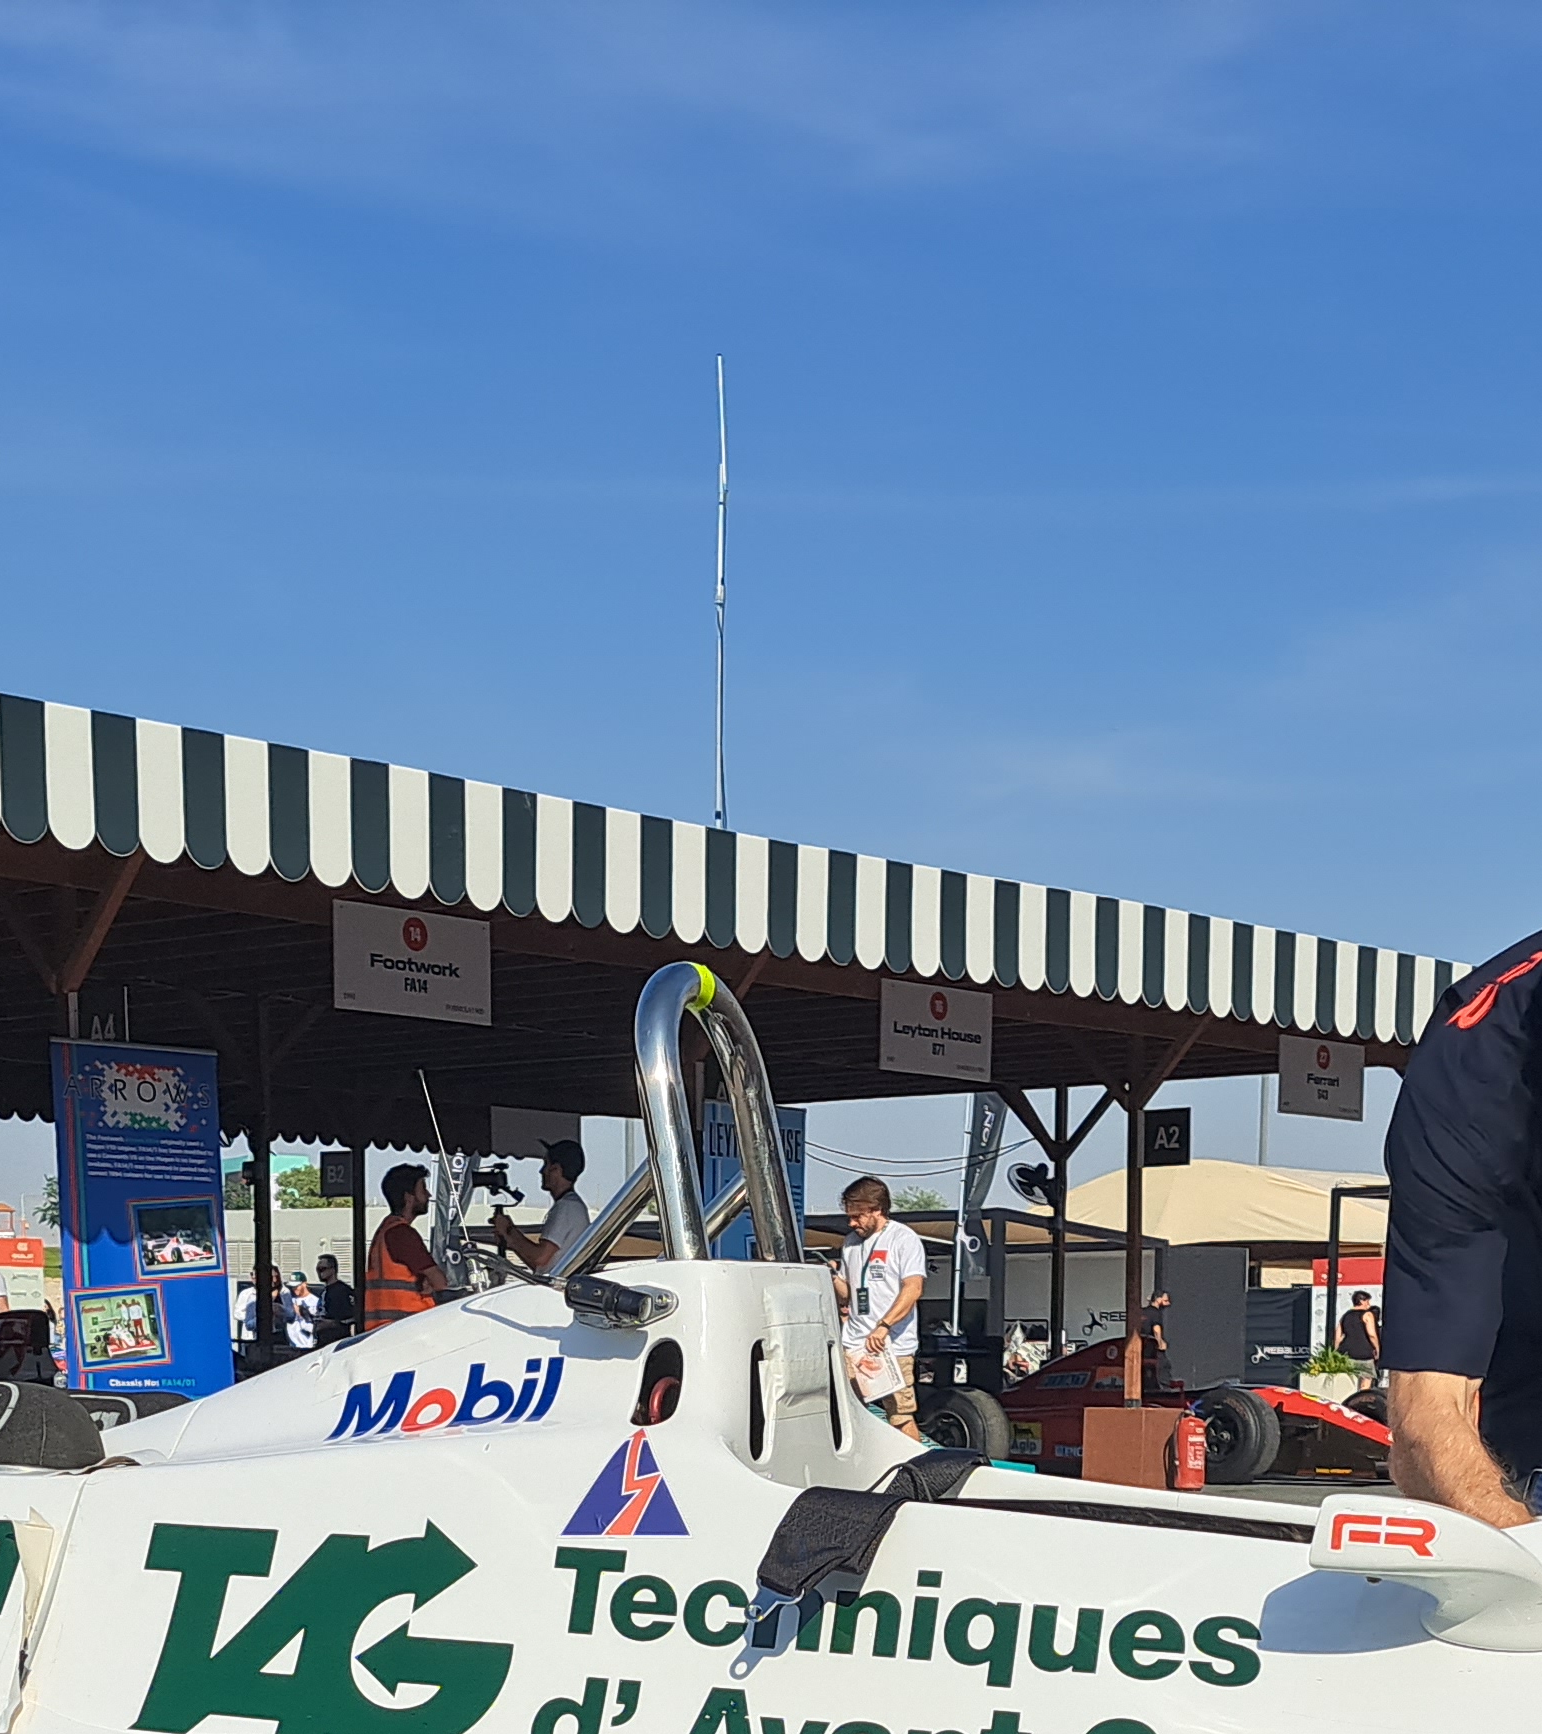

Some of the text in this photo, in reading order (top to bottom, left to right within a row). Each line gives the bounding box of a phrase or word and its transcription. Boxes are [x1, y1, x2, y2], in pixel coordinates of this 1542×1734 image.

[409, 926, 422, 942] 14
[370, 952, 461, 979] Footwork
[404, 977, 429, 994] FA14
[91, 1013, 116, 1041] A4
[893, 1020, 982, 1045] Leyton House
[63, 1074, 211, 1109] ARROWS
[1306, 1072, 1340, 1087] Ferrari
[1153, 1125, 1181, 1150] A2
[326, 1164, 346, 1183] B2
[326, 1356, 566, 1442] Mobil
[1010, 1440, 1037, 1452] Agip
[1329, 1513, 1438, 1558] FR
[554, 1545, 1263, 1688] Techniques
